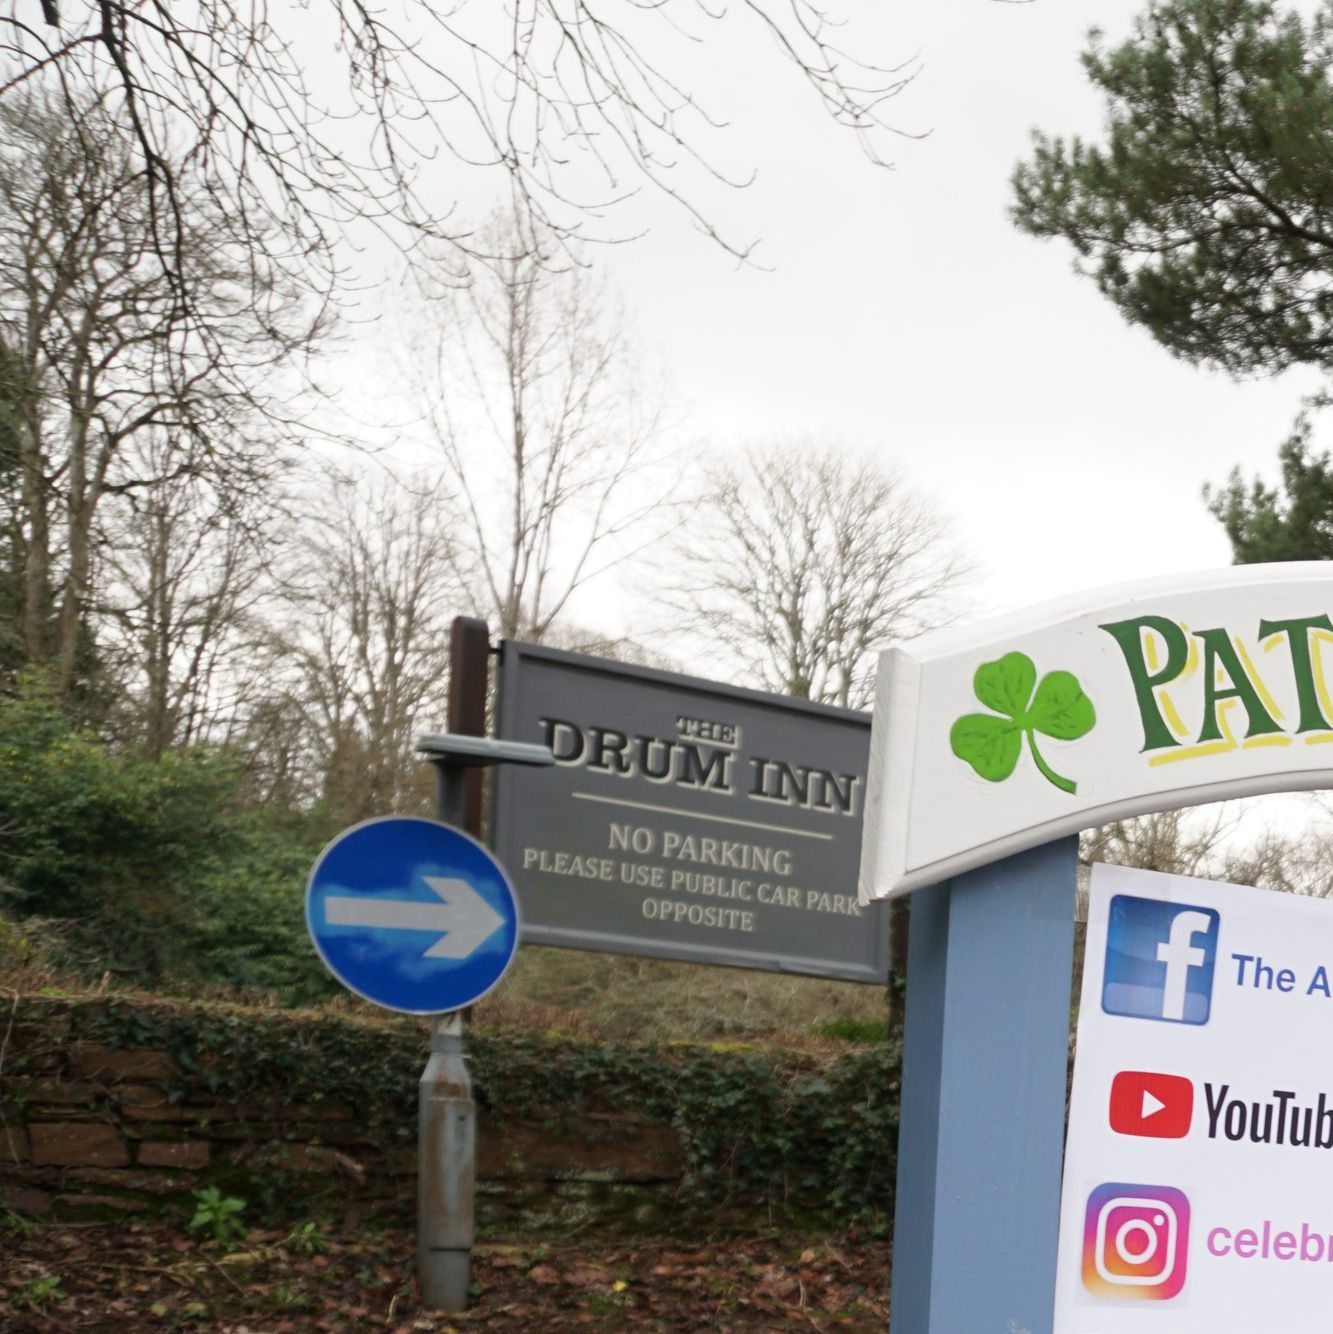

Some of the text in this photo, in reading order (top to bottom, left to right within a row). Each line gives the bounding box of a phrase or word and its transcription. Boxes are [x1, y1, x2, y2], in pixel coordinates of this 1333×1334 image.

[675, 716, 743, 750] THE
[539, 716, 862, 817] DRUM INN
[608, 823, 794, 876] NO PARKING
[522, 848, 862, 916] PLEASE USE PUBLIC CAR PARK
[641, 898, 755, 932] OPPOSITE
[1230, 952, 1296, 993] The
